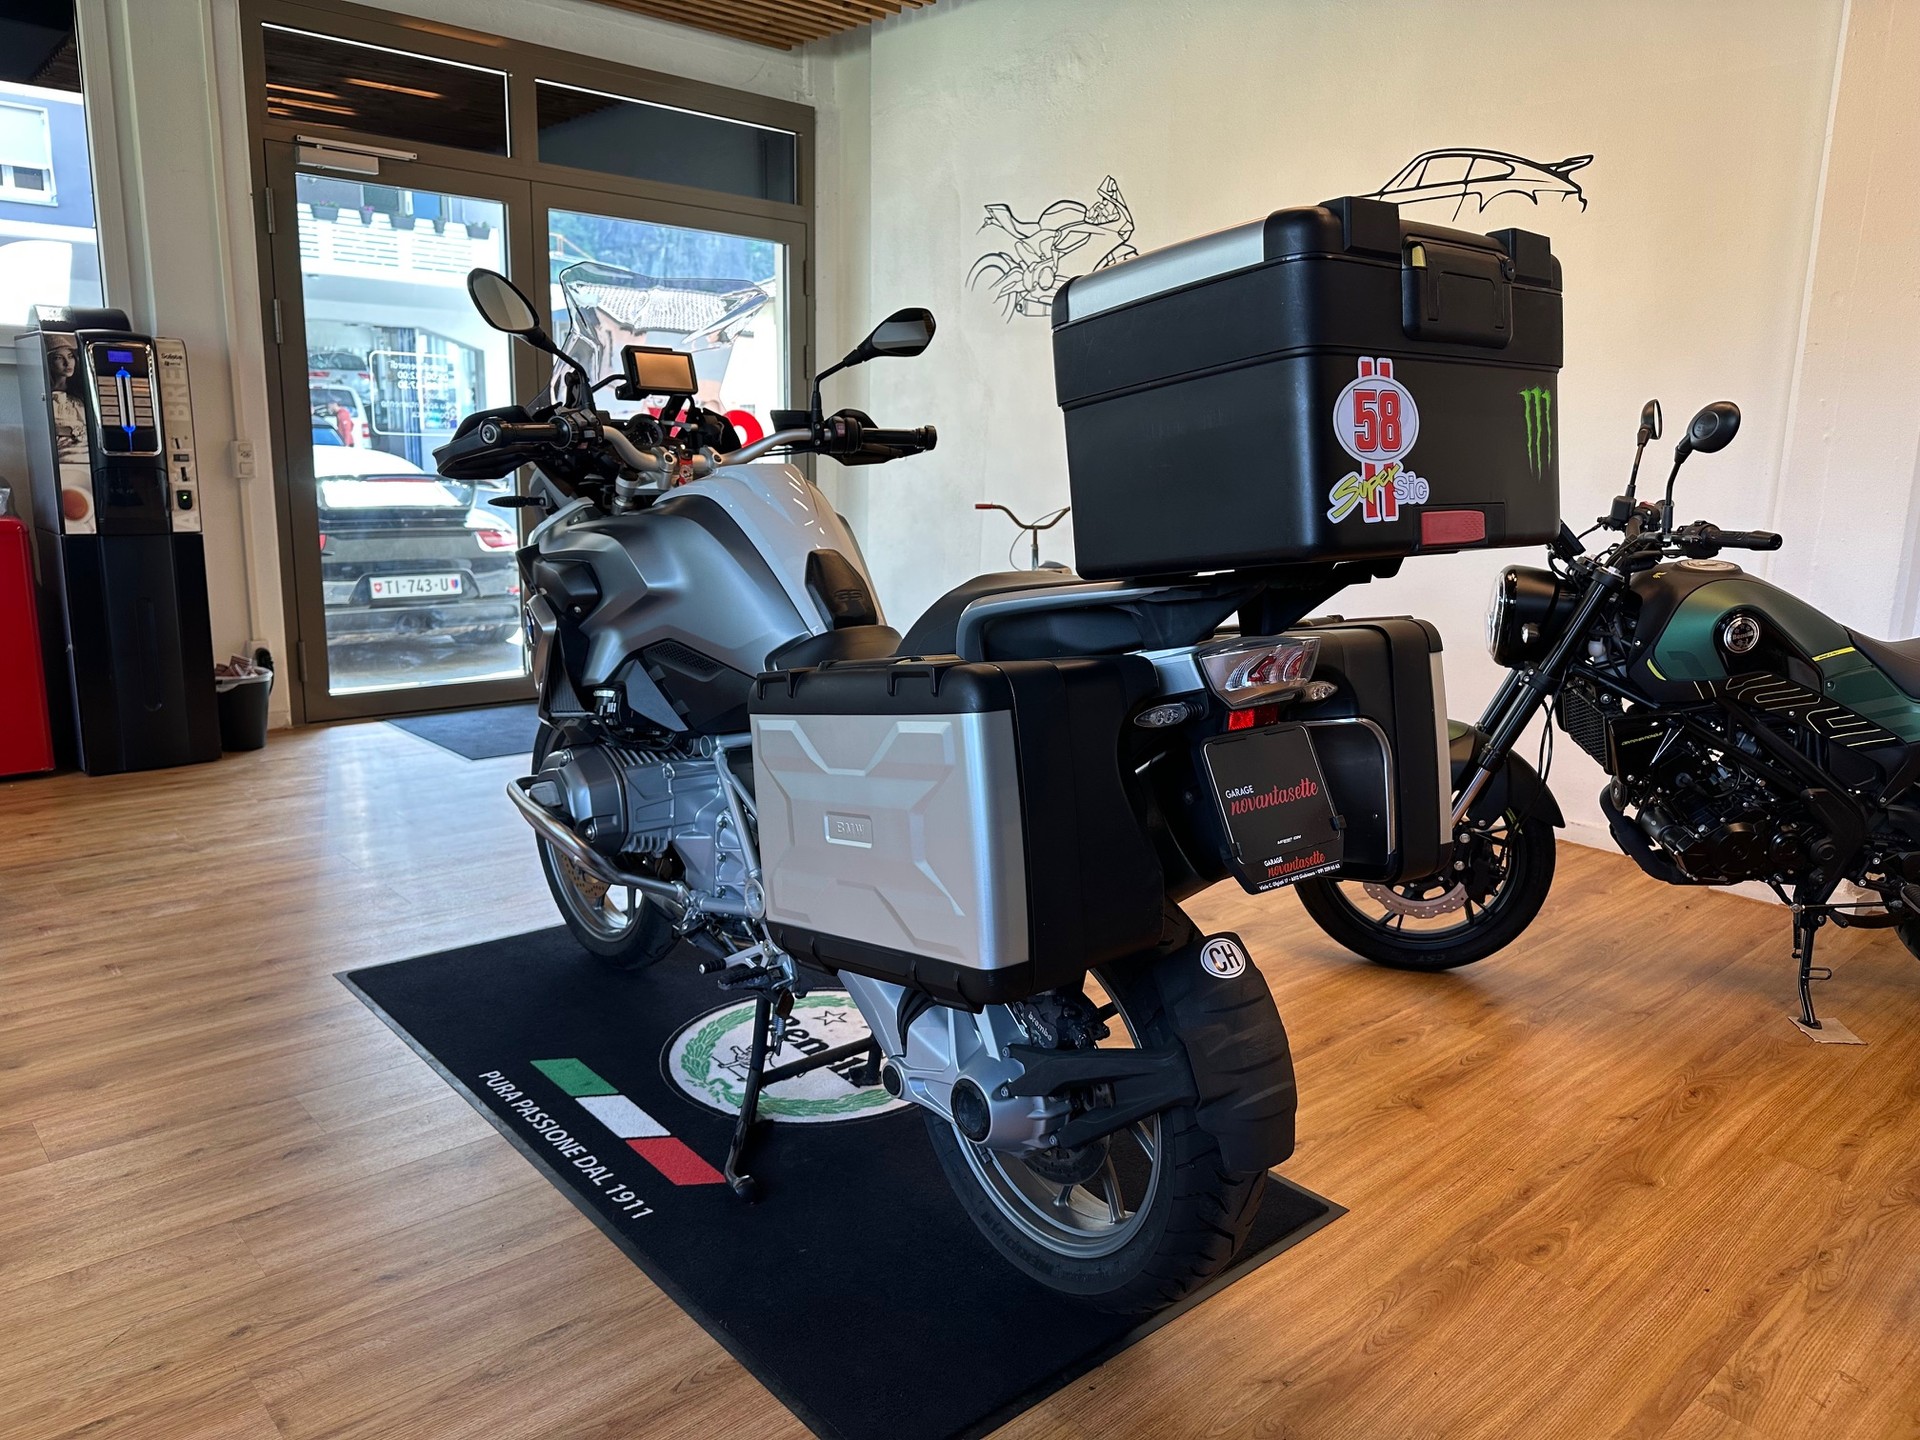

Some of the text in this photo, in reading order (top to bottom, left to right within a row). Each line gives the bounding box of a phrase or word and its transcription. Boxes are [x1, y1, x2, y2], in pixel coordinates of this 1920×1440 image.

[1353, 389, 1402, 452] 58
[1331, 464, 1428, 519] Super Sic
[1225, 785, 1255, 799] GARAGE
[1231, 778, 1318, 816] novantasette
[1264, 856, 1283, 867] GARAGE
[1268, 850, 1326, 877] novantasette
[1209, 943, 1241, 972] CH
[1028, 1011, 1053, 1041] brembo
[478, 1070, 654, 1219] PURA PASSIONE DAL 1911
